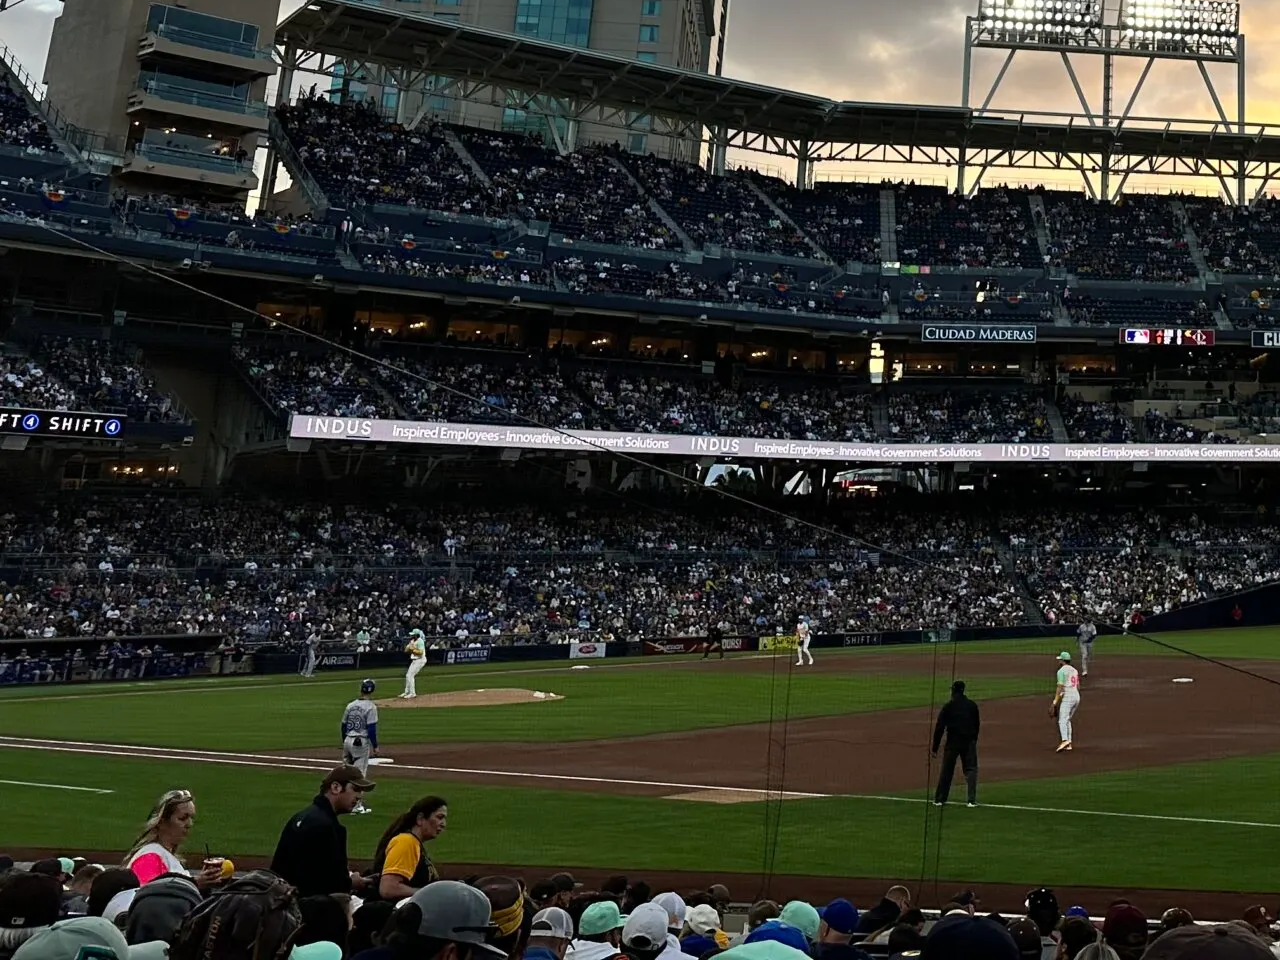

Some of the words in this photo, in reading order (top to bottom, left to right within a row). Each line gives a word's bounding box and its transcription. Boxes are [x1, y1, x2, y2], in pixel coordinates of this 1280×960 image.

[924, 326, 977, 340] CIUDAD
[978, 327, 1034, 341] MADERAS
[50, 417, 103, 433] SHIFT
[306, 418, 373, 436] INDUS
[392, 425, 438, 440] Inspired
[440, 427, 499, 443] Employees
[506, 430, 560, 445] Innovative
[562, 434, 623, 448] Government
[625, 436, 670, 449] Solutions
[691, 438, 739, 453] INDUS
[754, 443, 789, 457] Inspired
[790, 444, 835, 458] Employees
[839, 446, 880, 458] Innovative
[881, 447, 938, 459] Government
[939, 447, 982, 458] Solutions
[1001, 446, 1050, 459] INDUS
[1065, 448, 1100, 459] Inspired
[1102, 448, 1149, 460] Employees
[1155, 448, 1199, 458] Innovative
[1201, 448, 1253, 459] Government
[456, 649, 488, 658] CUTWATER
[203, 916, 221, 960] ASTON
